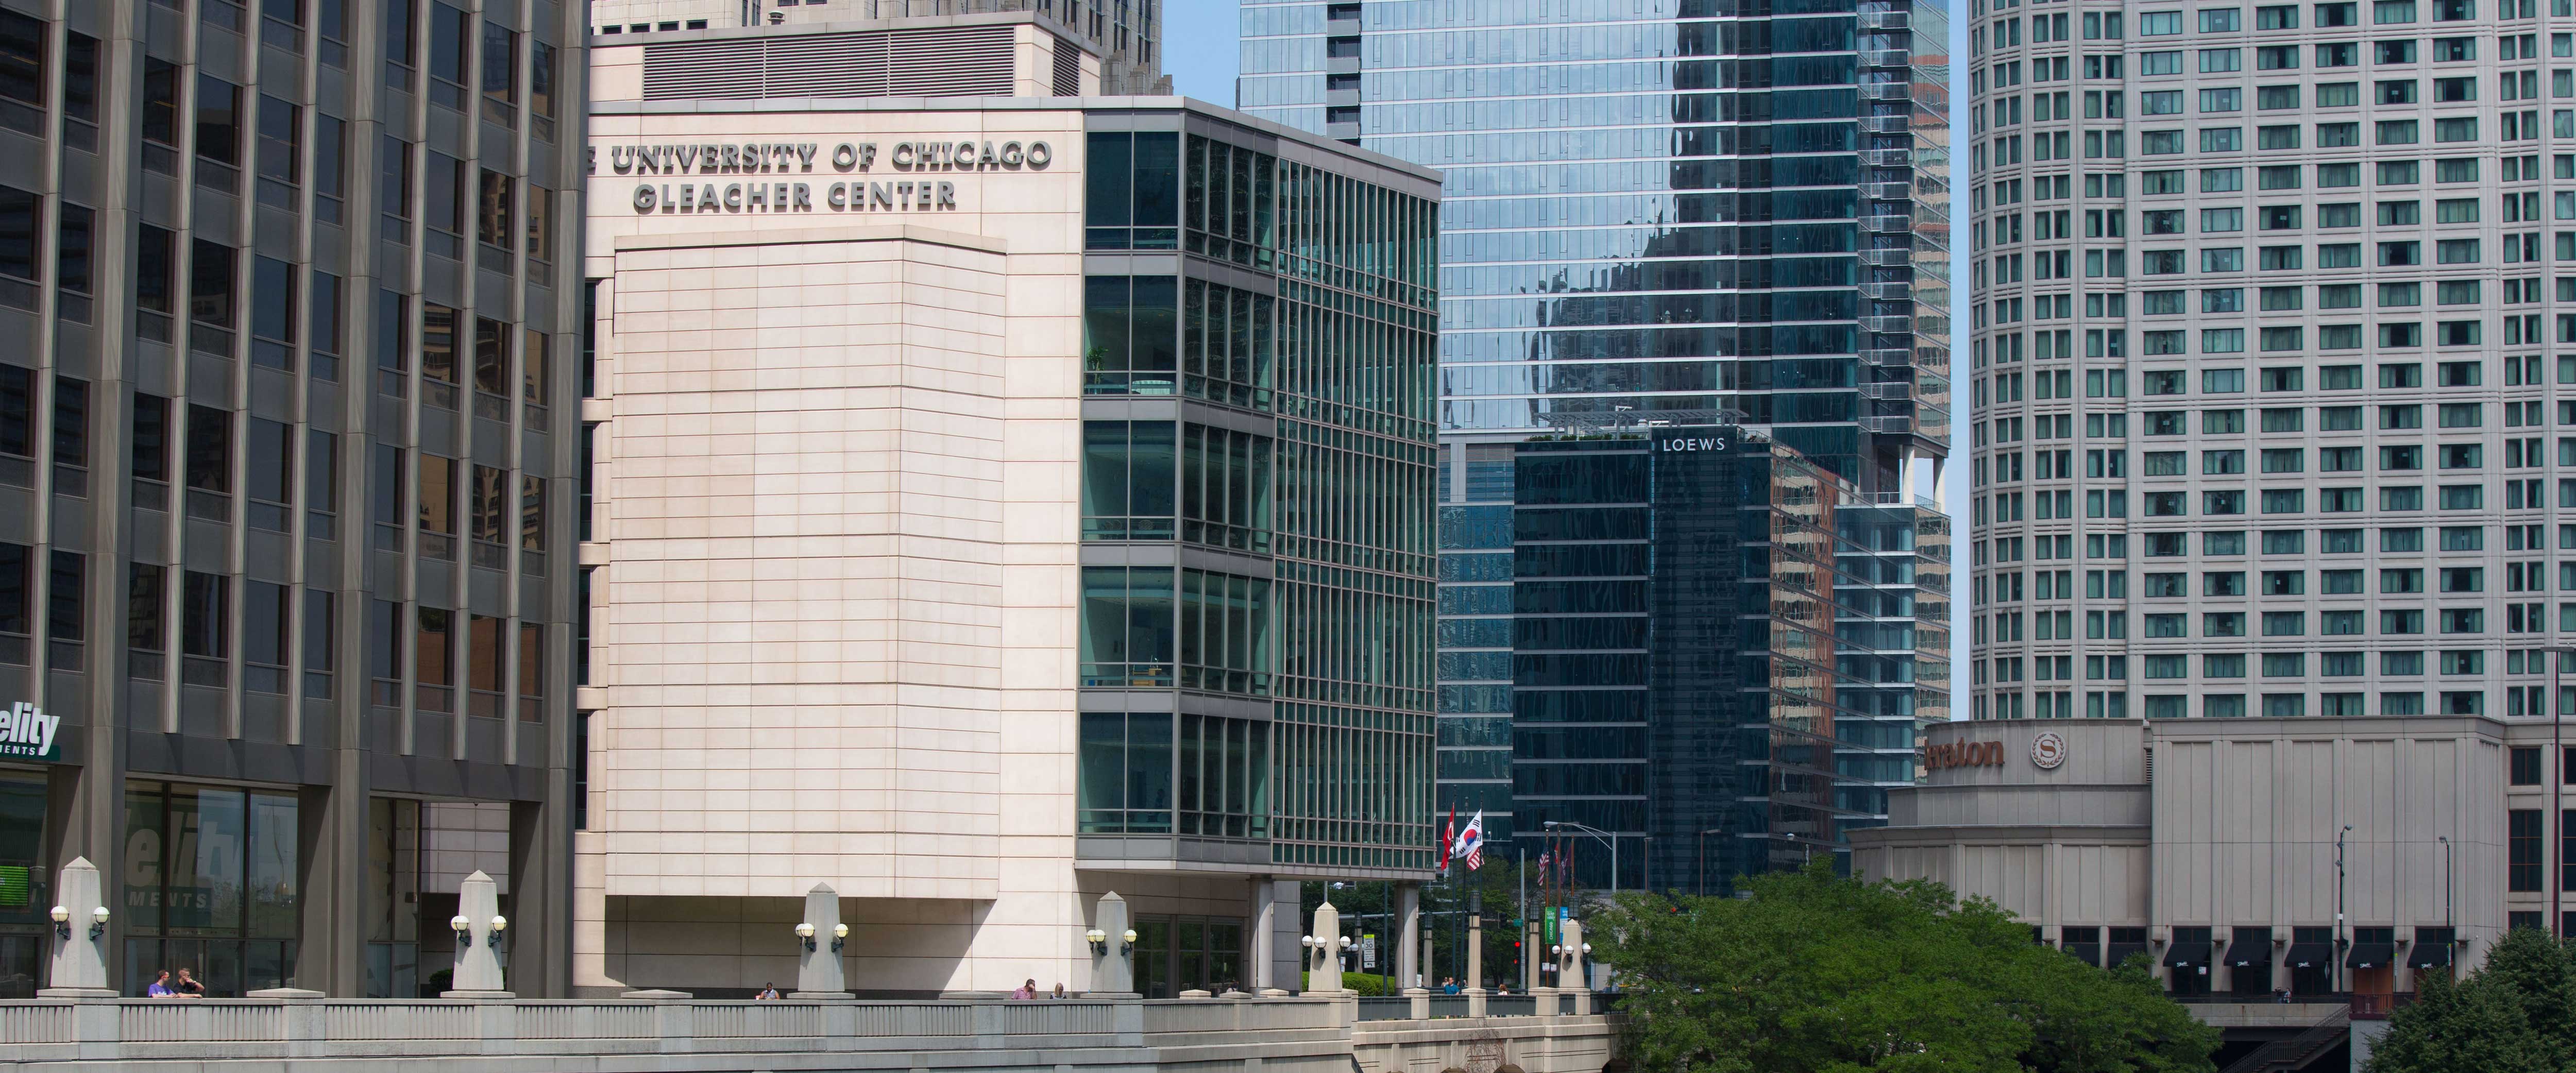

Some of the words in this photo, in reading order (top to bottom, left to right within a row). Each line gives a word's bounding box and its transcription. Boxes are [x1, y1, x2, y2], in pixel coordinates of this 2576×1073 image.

[612, 143, 818, 171] UNIVERSITY
[833, 142, 877, 169] OF
[892, 141, 1052, 168] CHICAGO
[634, 182, 812, 211] GLEACHER
[828, 181, 956, 209] CENTER
[1663, 437, 1725, 451] LOEWS
[2040, 739, 2056, 758] S
